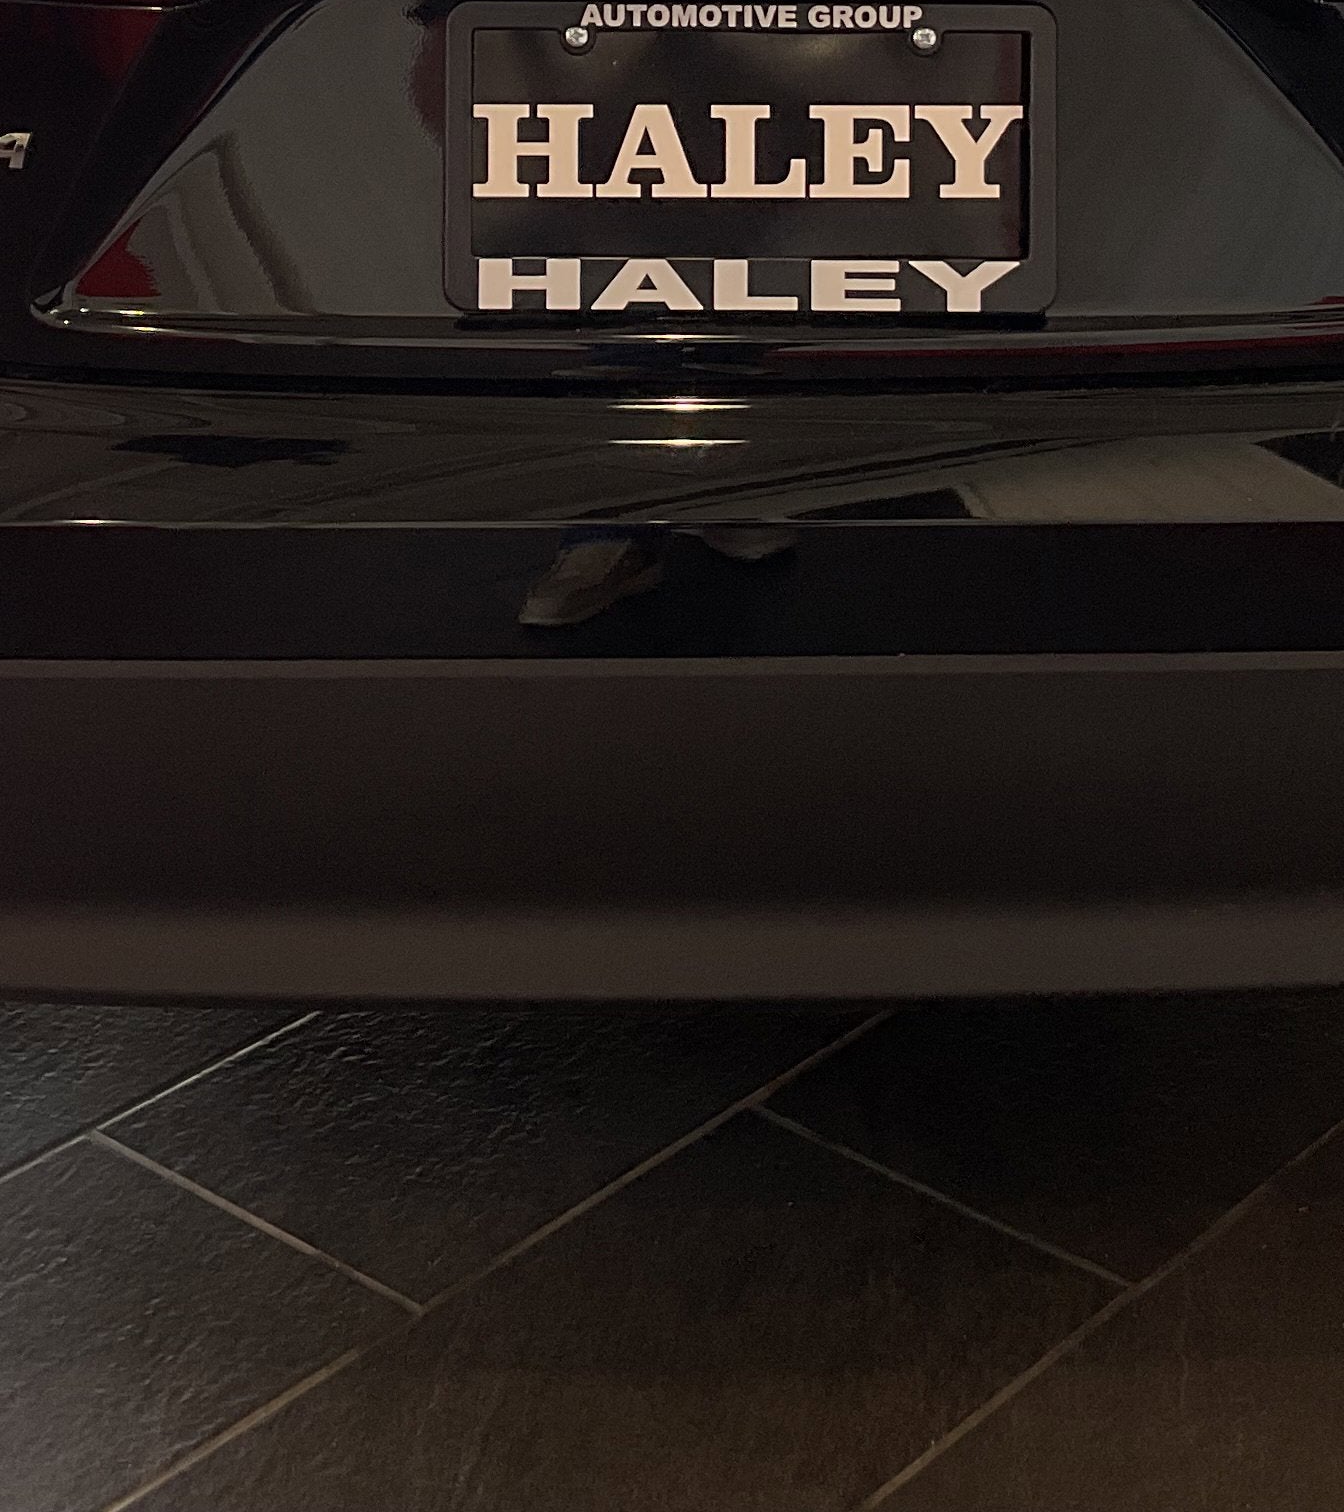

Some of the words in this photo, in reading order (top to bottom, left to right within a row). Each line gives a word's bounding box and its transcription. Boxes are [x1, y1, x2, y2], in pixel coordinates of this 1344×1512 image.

[580, 4, 797, 28] AUTOMOTIVE
[807, 4, 923, 29] GROUP
[472, 103, 1024, 199] HALEY
[478, 258, 1022, 313] HALEY
